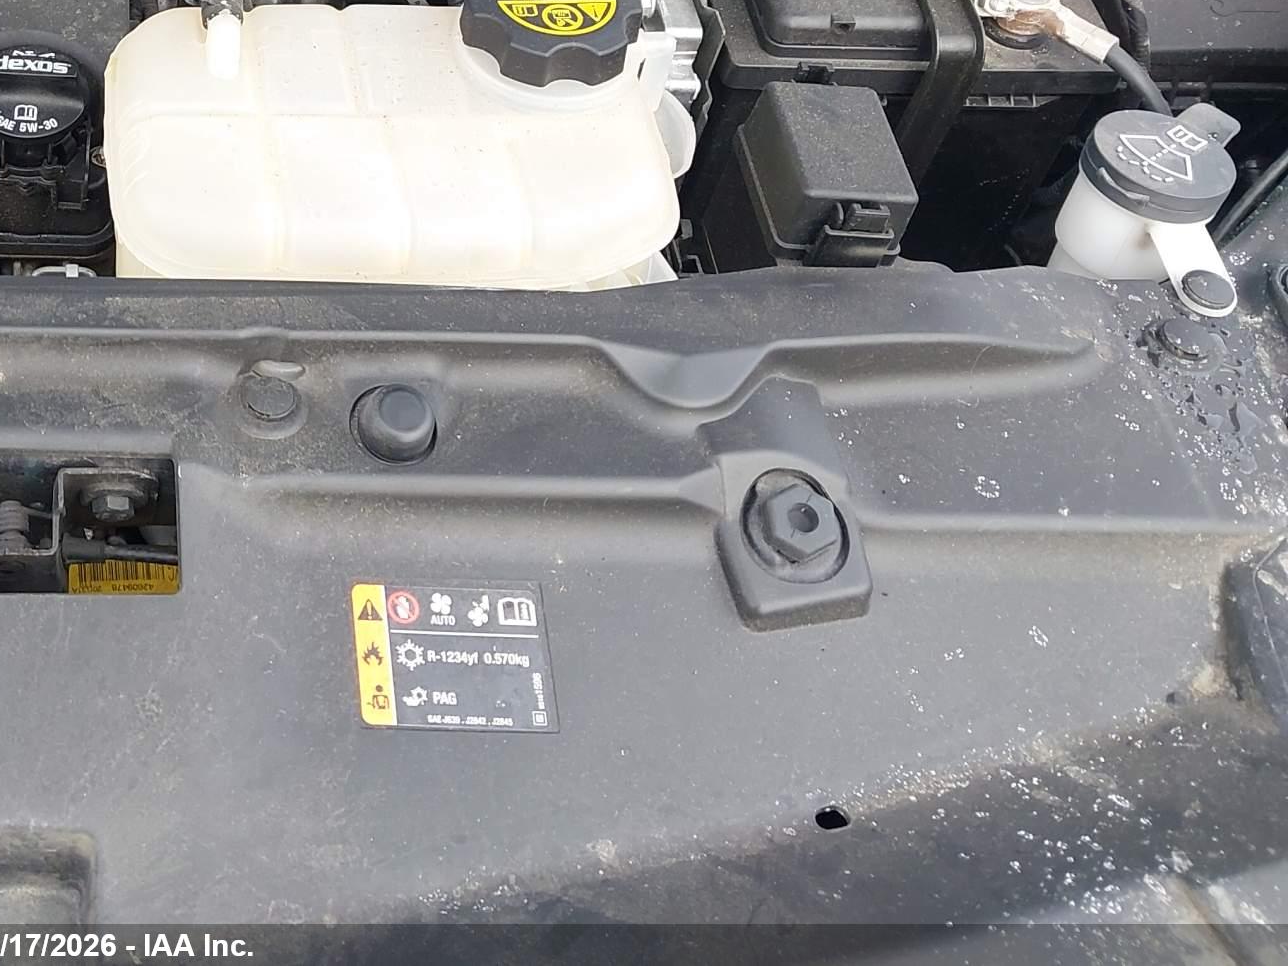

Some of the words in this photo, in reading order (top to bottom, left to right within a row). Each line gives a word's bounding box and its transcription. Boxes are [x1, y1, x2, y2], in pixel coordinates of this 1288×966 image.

[19, 118, 59, 133] 5W-30
[430, 614, 456, 626] AUTO
[427, 649, 479, 666] R-1234yf
[484, 651, 530, 668] 0.570kg
[432, 691, 458, 706] PAG
